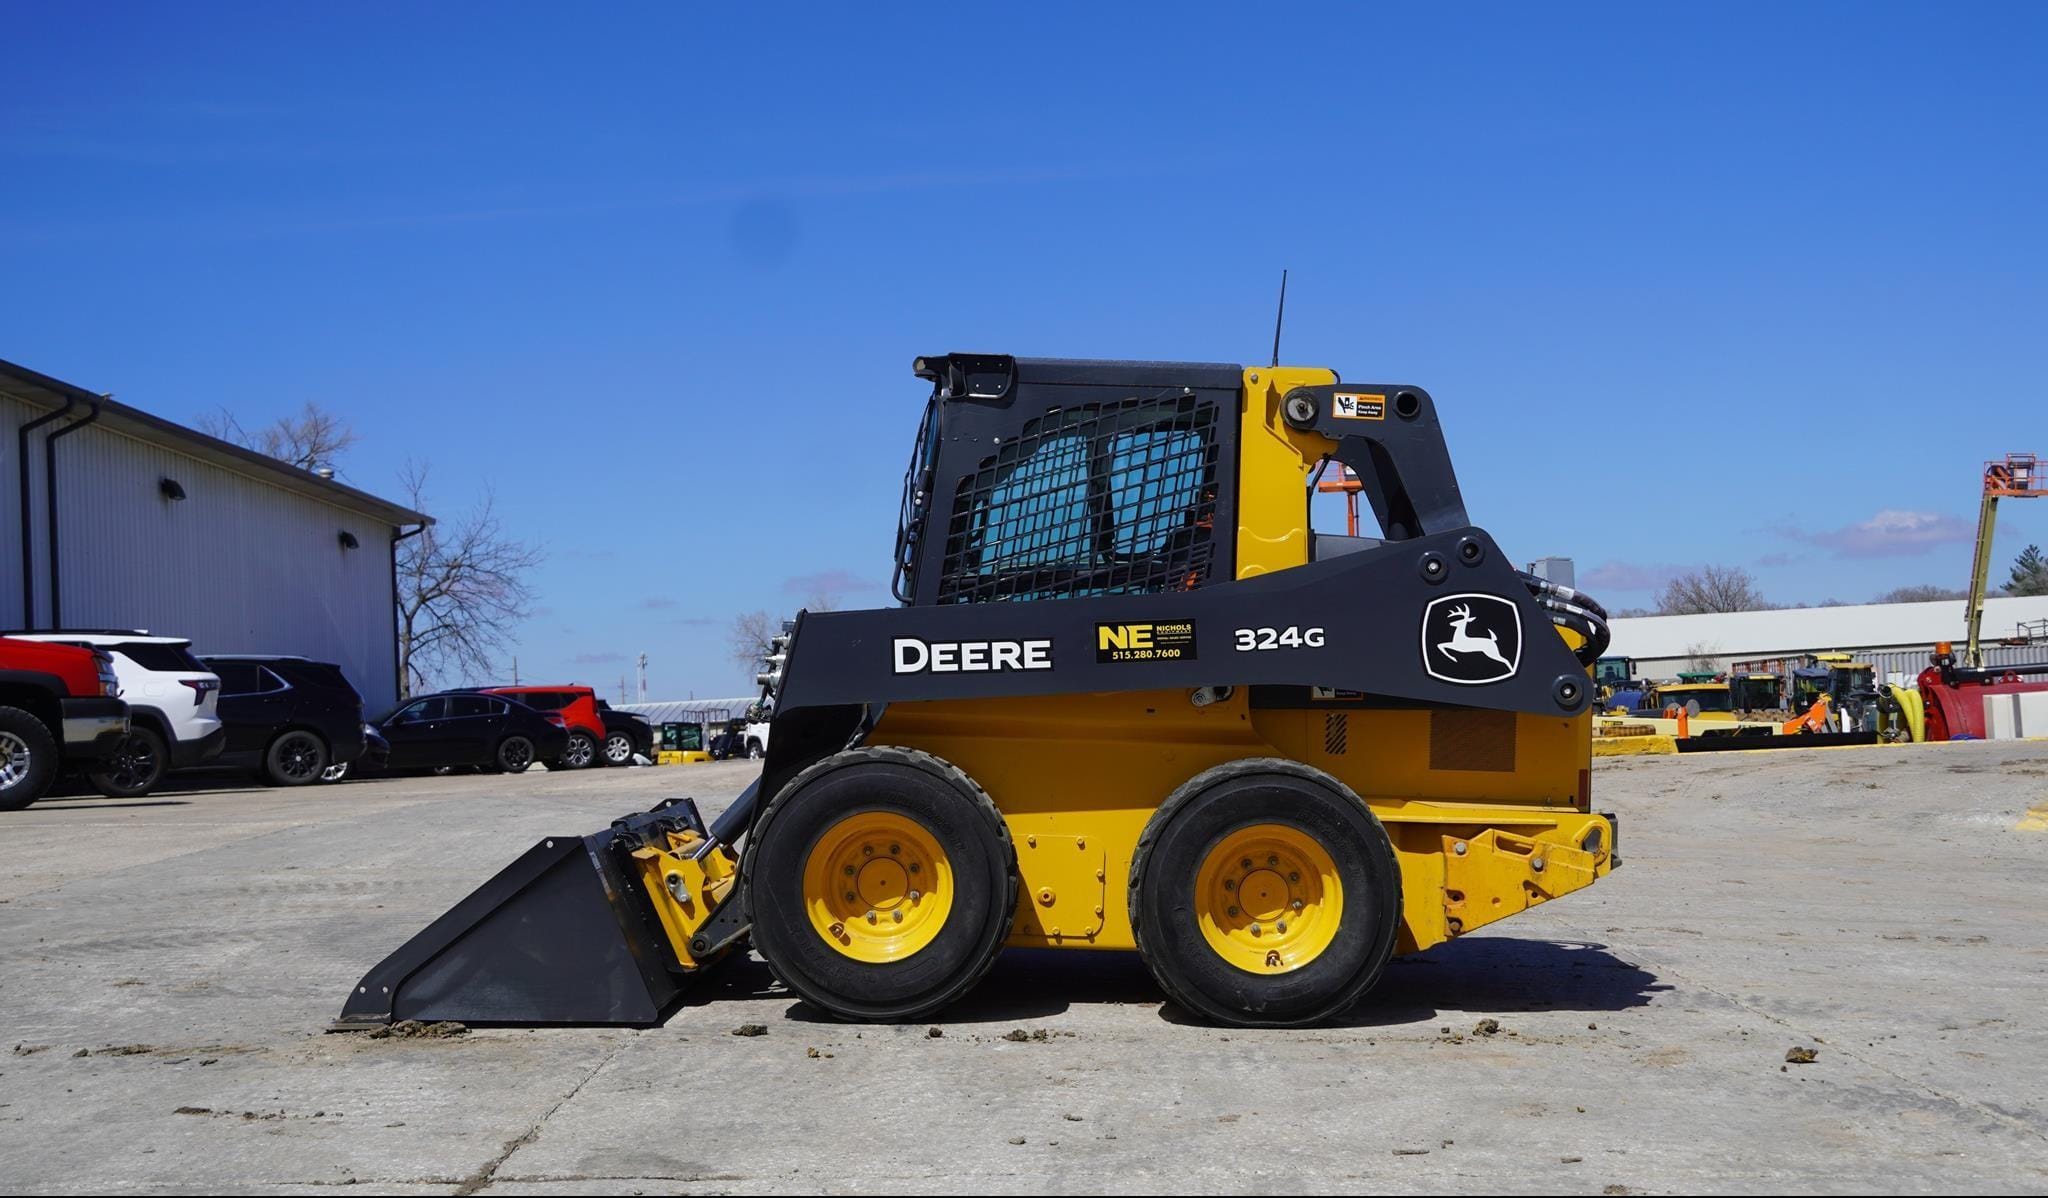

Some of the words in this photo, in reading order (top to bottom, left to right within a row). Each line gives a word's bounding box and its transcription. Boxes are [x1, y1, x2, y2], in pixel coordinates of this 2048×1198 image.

[1099, 624, 1153, 650] NE
[1156, 623, 1192, 631] NICHOLS
[1235, 626, 1325, 651] 324G
[894, 638, 1051, 673] DEERE
[1112, 648, 1181, 660] 515.280.7600
